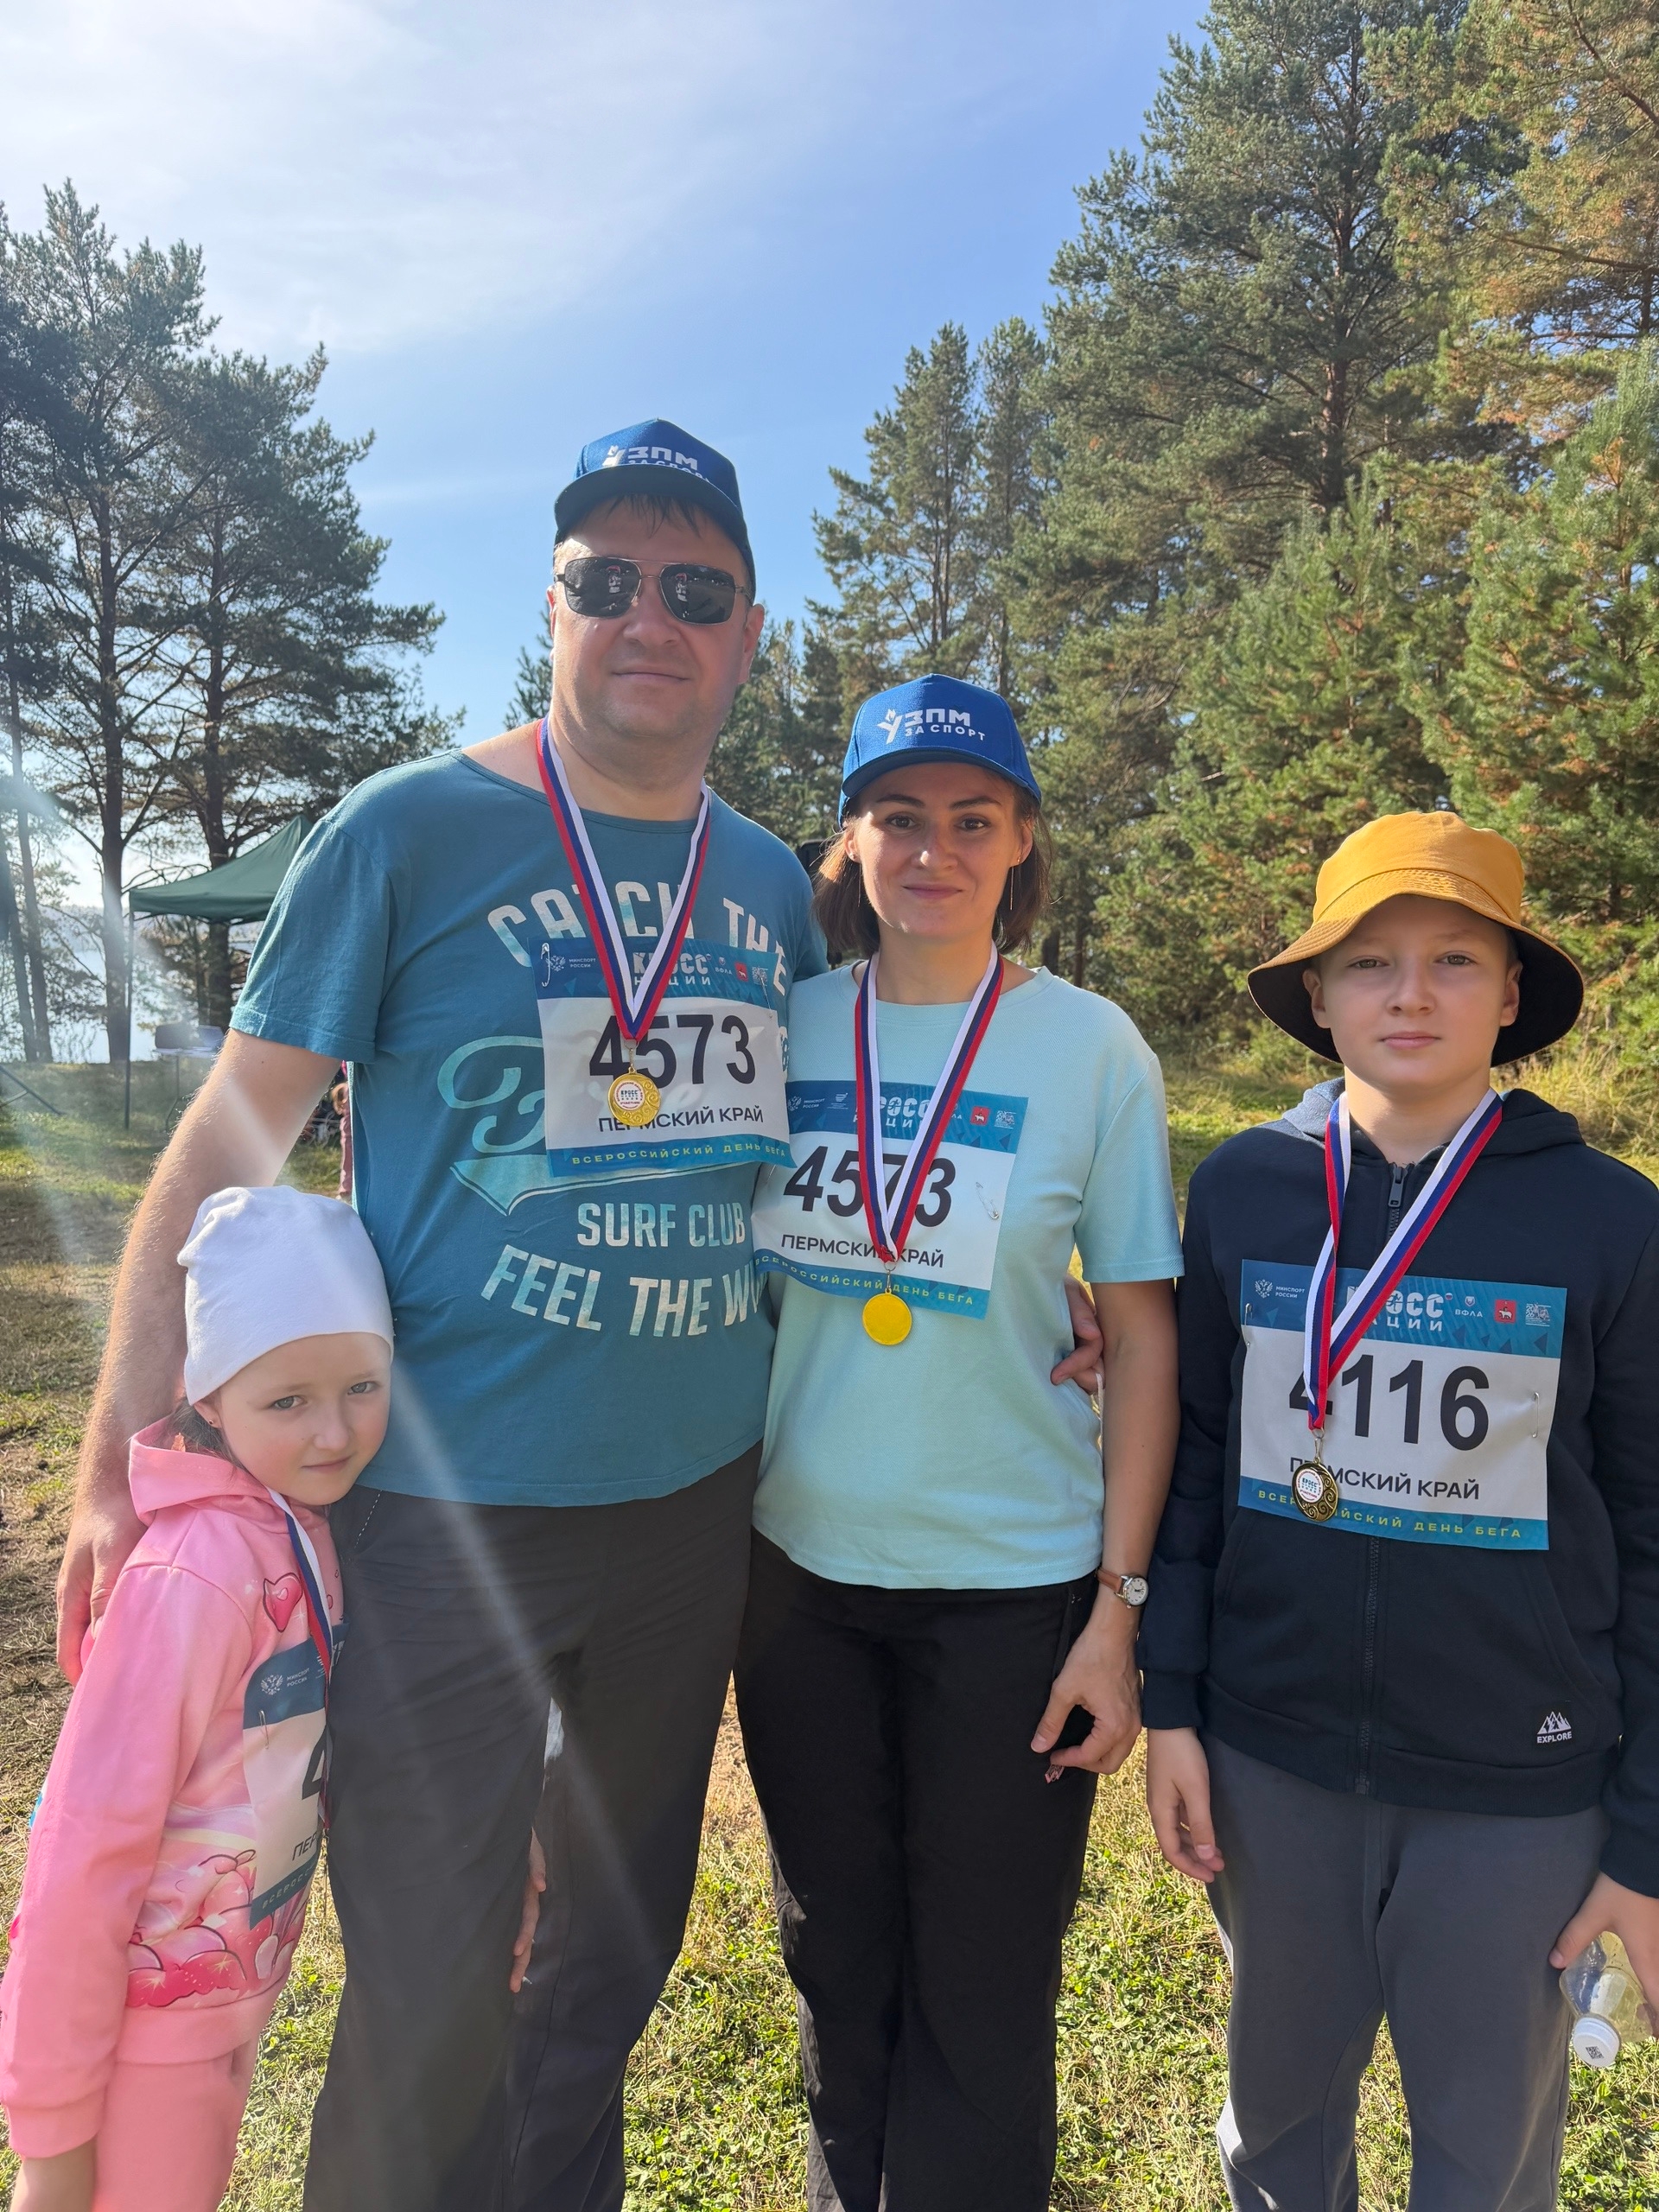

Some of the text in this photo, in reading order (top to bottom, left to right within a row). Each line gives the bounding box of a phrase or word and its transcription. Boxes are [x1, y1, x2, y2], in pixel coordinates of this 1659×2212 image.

[905, 724, 985, 741] ЗА СПОРТ
[632, 952, 709, 975] КСС
[589, 1014, 756, 1091] 4573
[719, 1104, 765, 1124] КРАЙ
[572, 1142, 786, 1165] ВСЕРОССИЙСКИЙ ДЕНЬ БЕГА
[577, 1202, 746, 1248] SURF CLUB
[781, 1234, 885, 1260] ПЕРМСКИ
[480, 1244, 602, 1332] FEEL
[629, 1277, 712, 1338] THE
[754, 1255, 973, 1306] ВСЕРОССИЙСКИЙ ДЕНЬ БЕГА
[1455, 1308, 1484, 1318] ВФЛА
[1290, 1457, 1480, 1500] ПМСКИЙ КРАЙ
[1414, 1521, 1463, 1535] ДЕНЬ
[1476, 1526, 1522, 1538] БЕГА
[1536, 1732, 1573, 1744] EXPLORE
